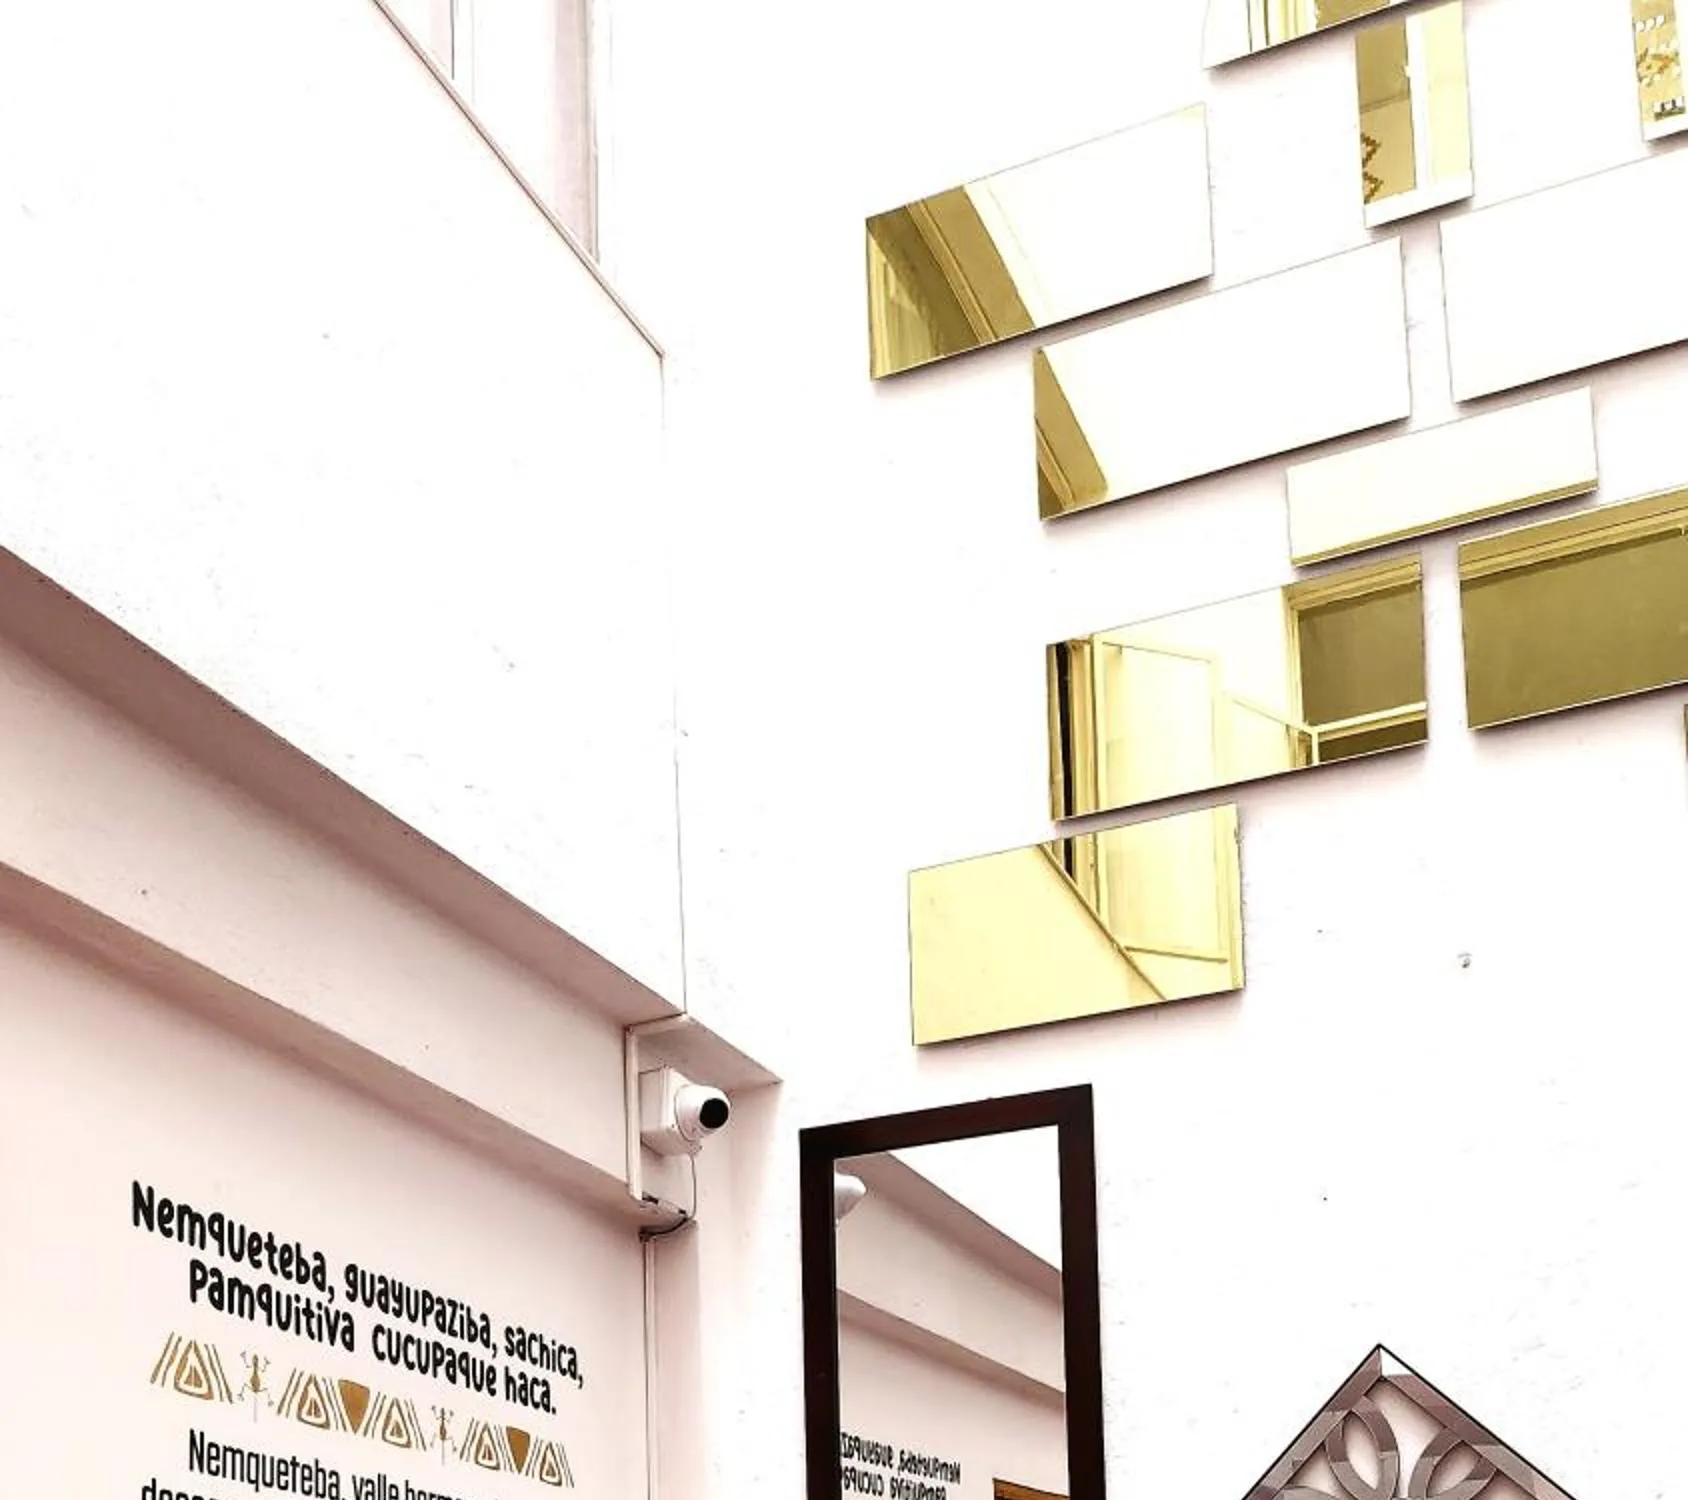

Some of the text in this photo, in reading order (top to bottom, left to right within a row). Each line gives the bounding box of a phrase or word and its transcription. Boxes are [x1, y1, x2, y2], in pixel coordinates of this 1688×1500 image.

[132, 1180, 584, 1390] Nemqueteba, guayupaziba, sachica,
[371, 1323, 497, 1397] cucupaque
[504, 1364, 557, 1415] haca.
